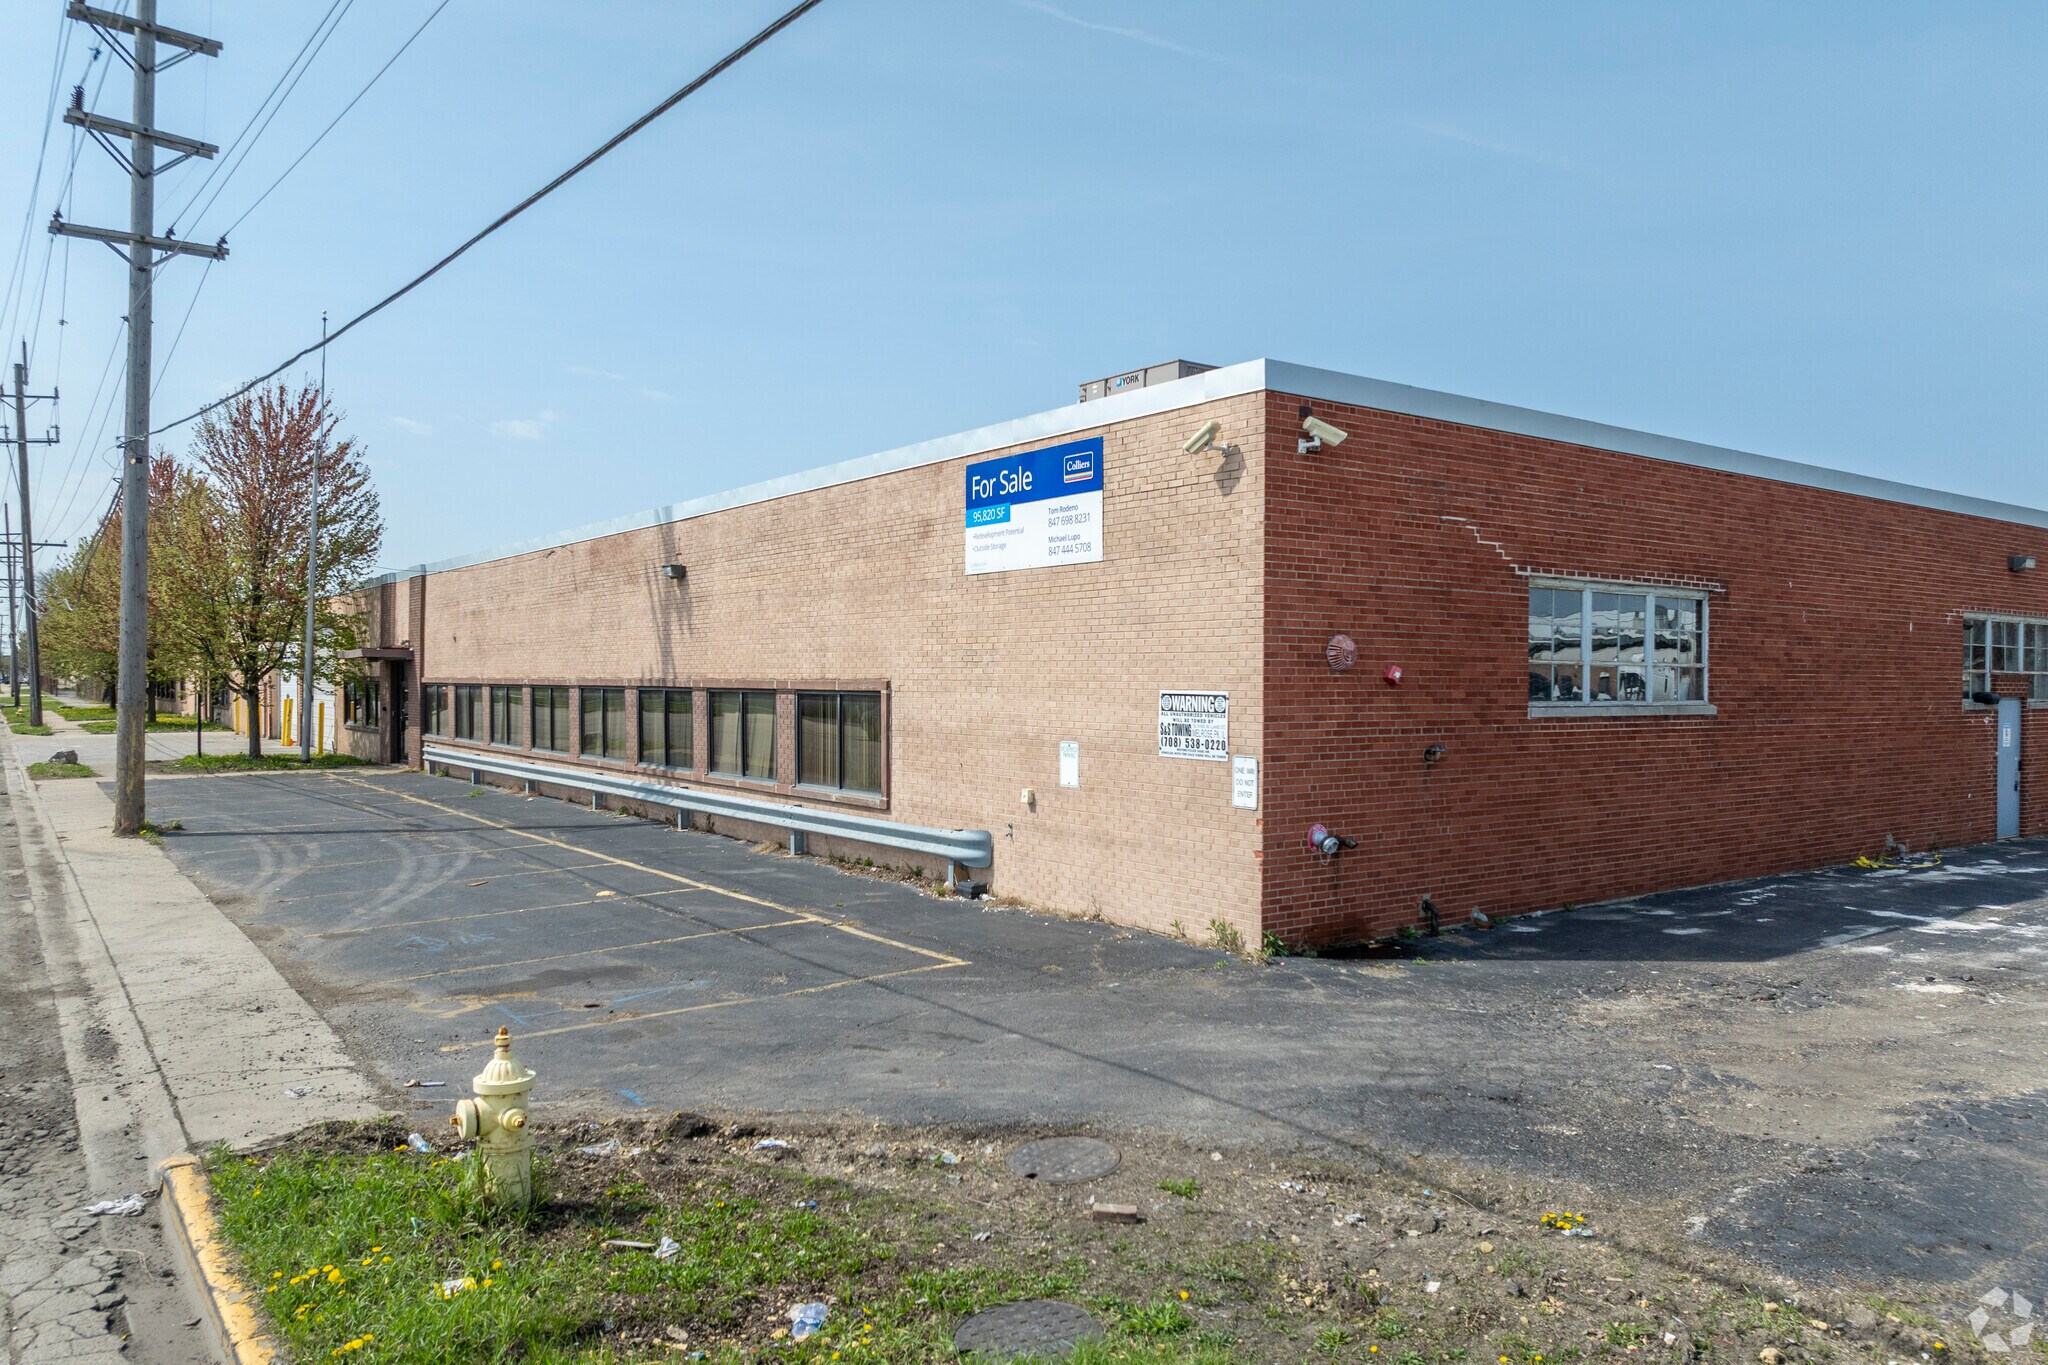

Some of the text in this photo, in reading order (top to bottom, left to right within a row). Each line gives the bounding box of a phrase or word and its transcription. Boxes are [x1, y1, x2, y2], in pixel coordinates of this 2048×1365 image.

[1122, 374, 1139, 385] YORK
[1067, 460, 1090, 471] Colliers
[972, 466, 1033, 500] For Sale
[973, 506, 1006, 523] 95,820 SF
[1048, 504, 1079, 515] Tom Rodeno
[1048, 512, 1091, 528] 847 698 8231
[1005, 527, 1024, 536] Potential
[1048, 533, 1081, 543] Michael Lupo
[990, 542, 1007, 551] Storage
[1048, 542, 1092, 556] 847 444 5708
[1171, 695, 1214, 712] WARNING
[1160, 722, 1171, 736] S&S
[1171, 723, 1191, 736] TOWING
[1161, 737, 1226, 750] (708) 538-0220
[1235, 766, 1245, 774] ONE
[1235, 778, 1254, 787] DO NOT
[1237, 790, 1253, 798] ENTER
